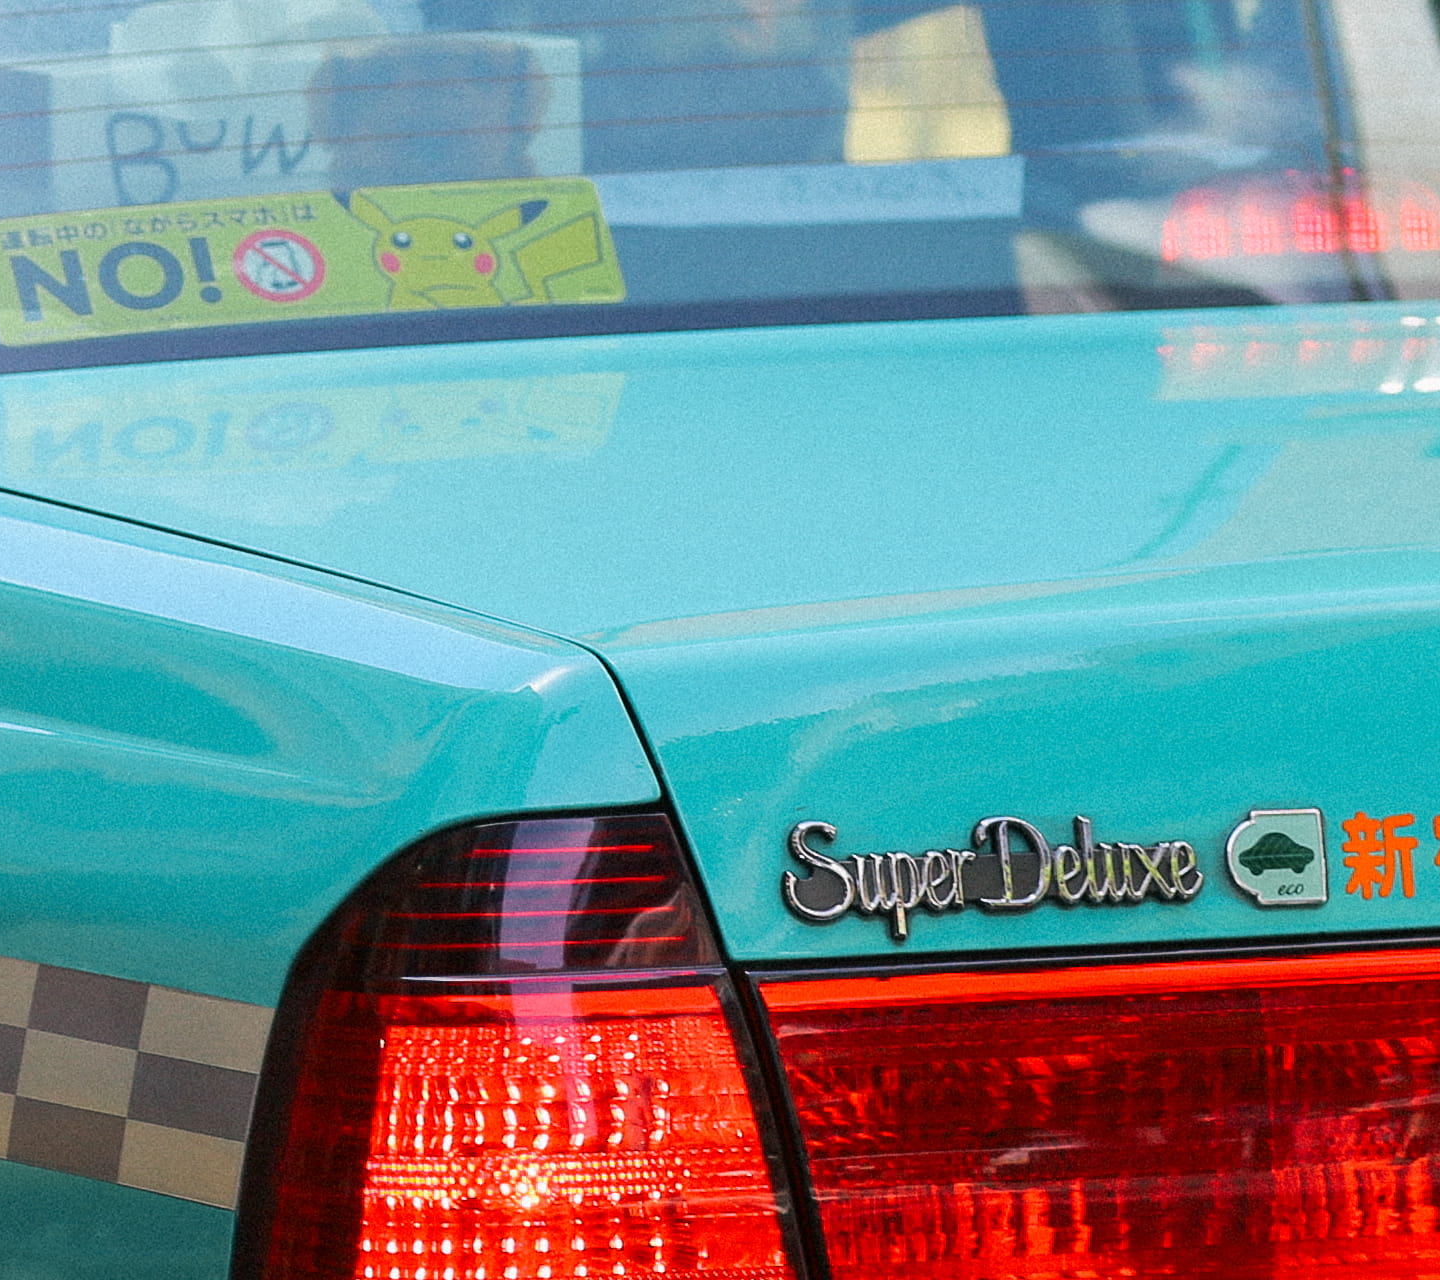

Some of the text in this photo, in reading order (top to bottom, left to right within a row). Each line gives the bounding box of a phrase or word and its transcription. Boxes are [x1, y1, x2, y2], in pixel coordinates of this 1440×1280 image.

[10, 236, 224, 322] NO!
[783, 814, 1204, 940] Super Deluxe
[1278, 883, 1305, 896] eco
